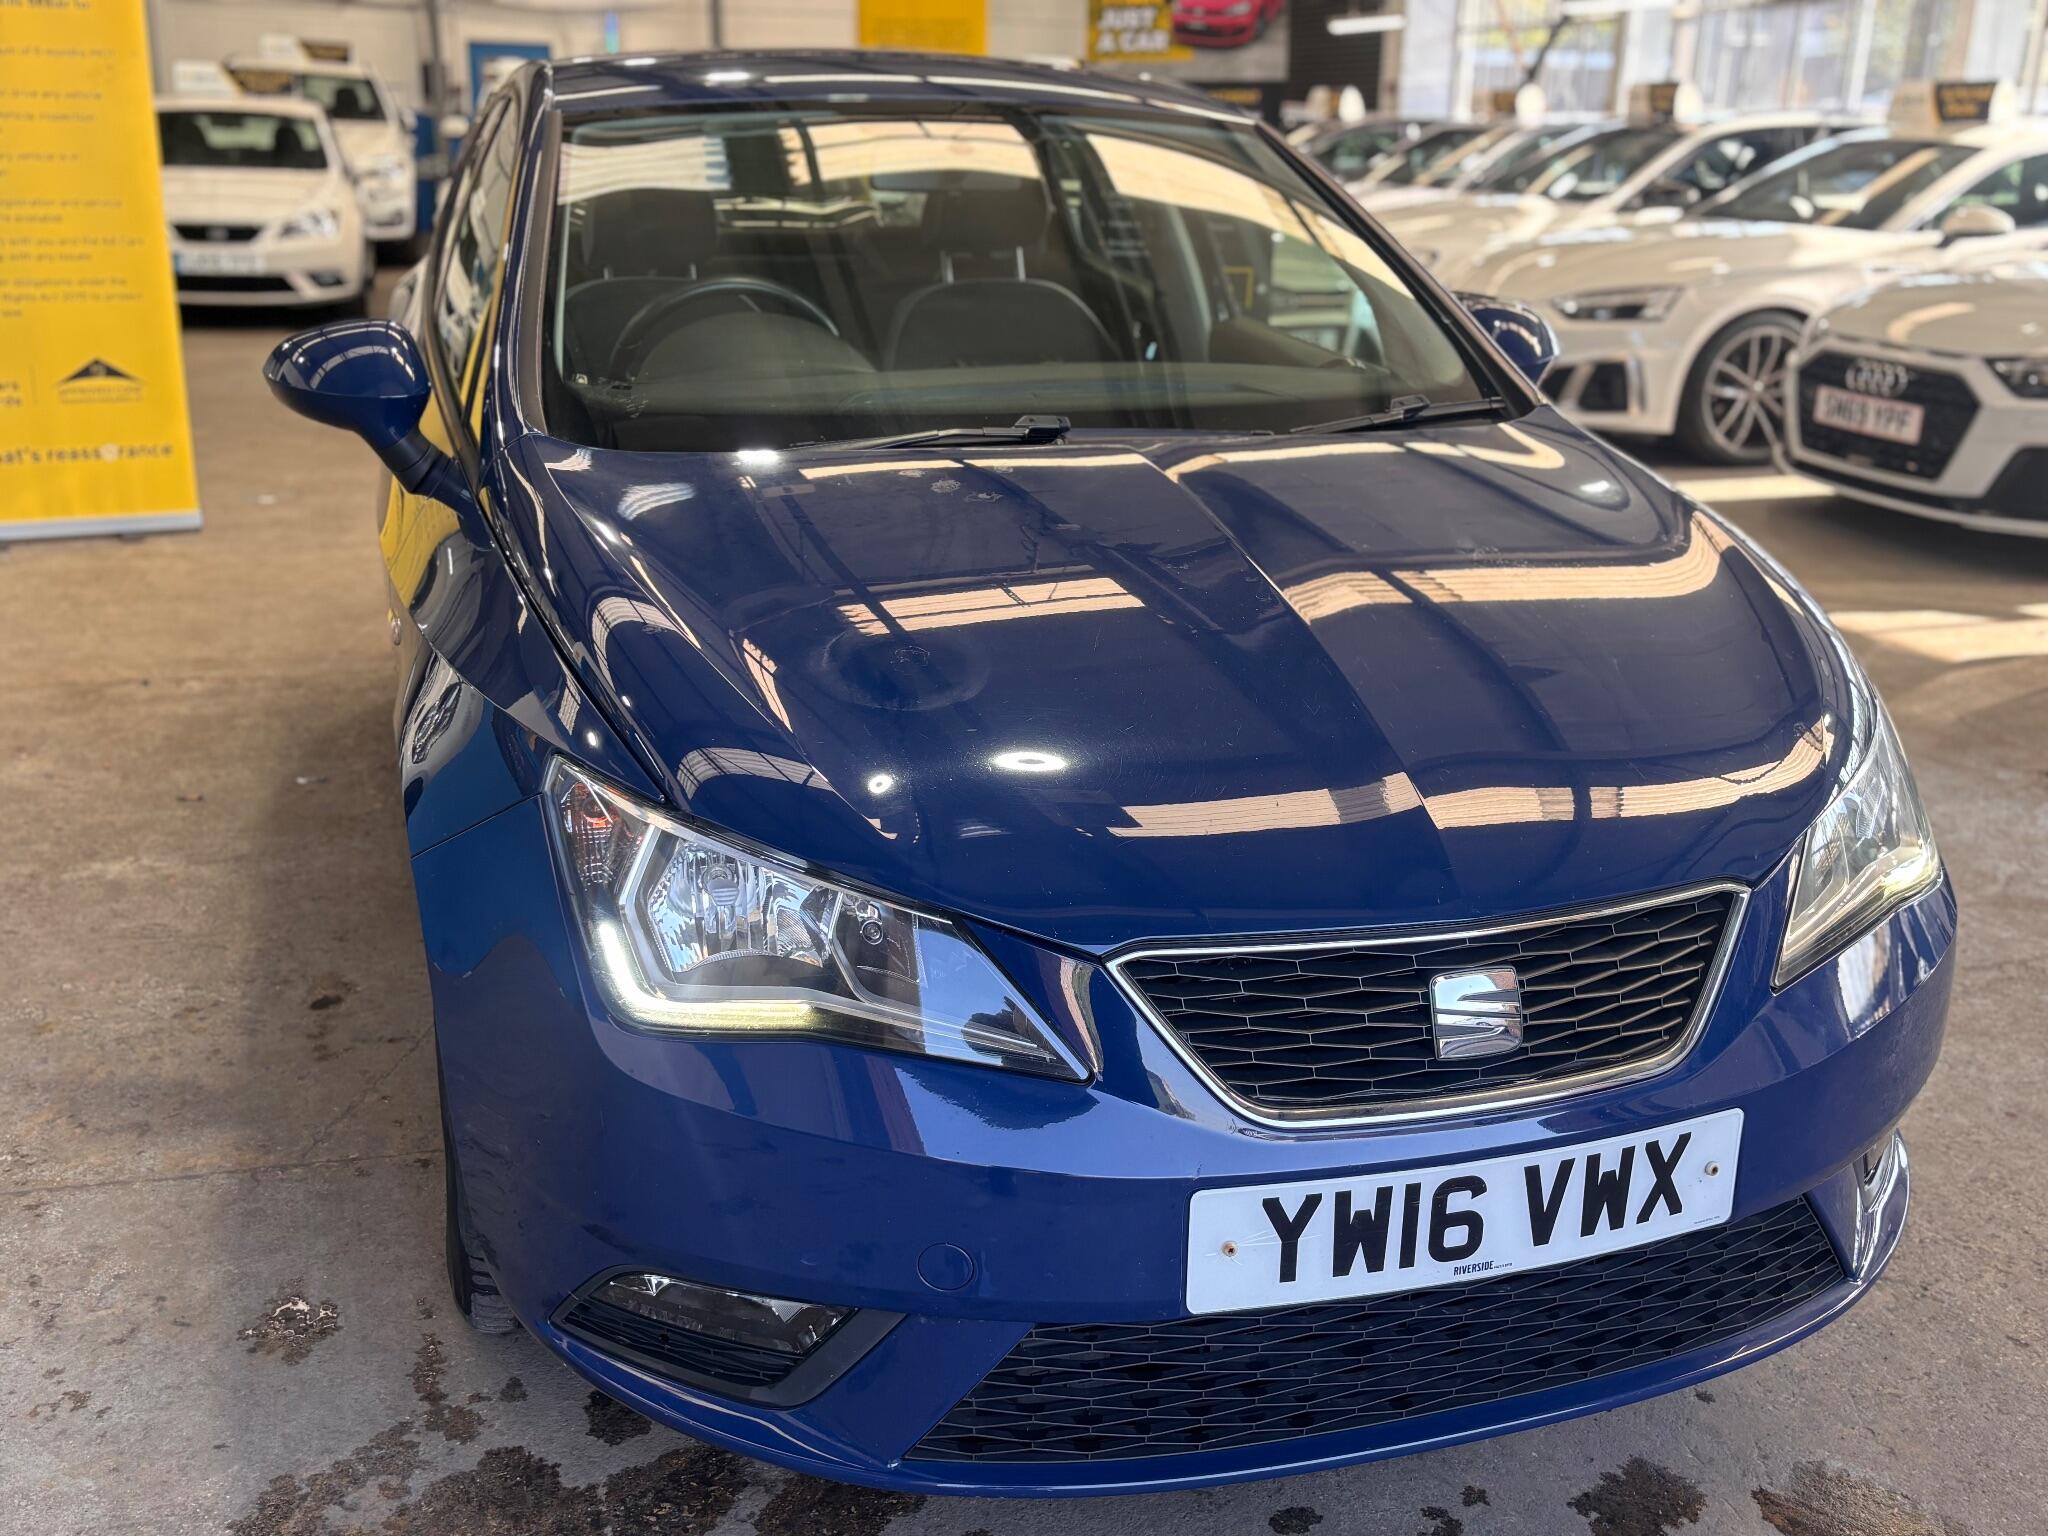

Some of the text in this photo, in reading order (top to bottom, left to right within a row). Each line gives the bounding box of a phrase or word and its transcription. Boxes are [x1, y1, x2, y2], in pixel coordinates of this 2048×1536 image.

[1099, 6, 1157, 29] JUST
[1121, 30, 1169, 52] CAR
[47, 441, 174, 463] reassrance
[1262, 1131, 1692, 1284] YW16 VWX
[1453, 1260, 1495, 1276] RIVERSIDE
